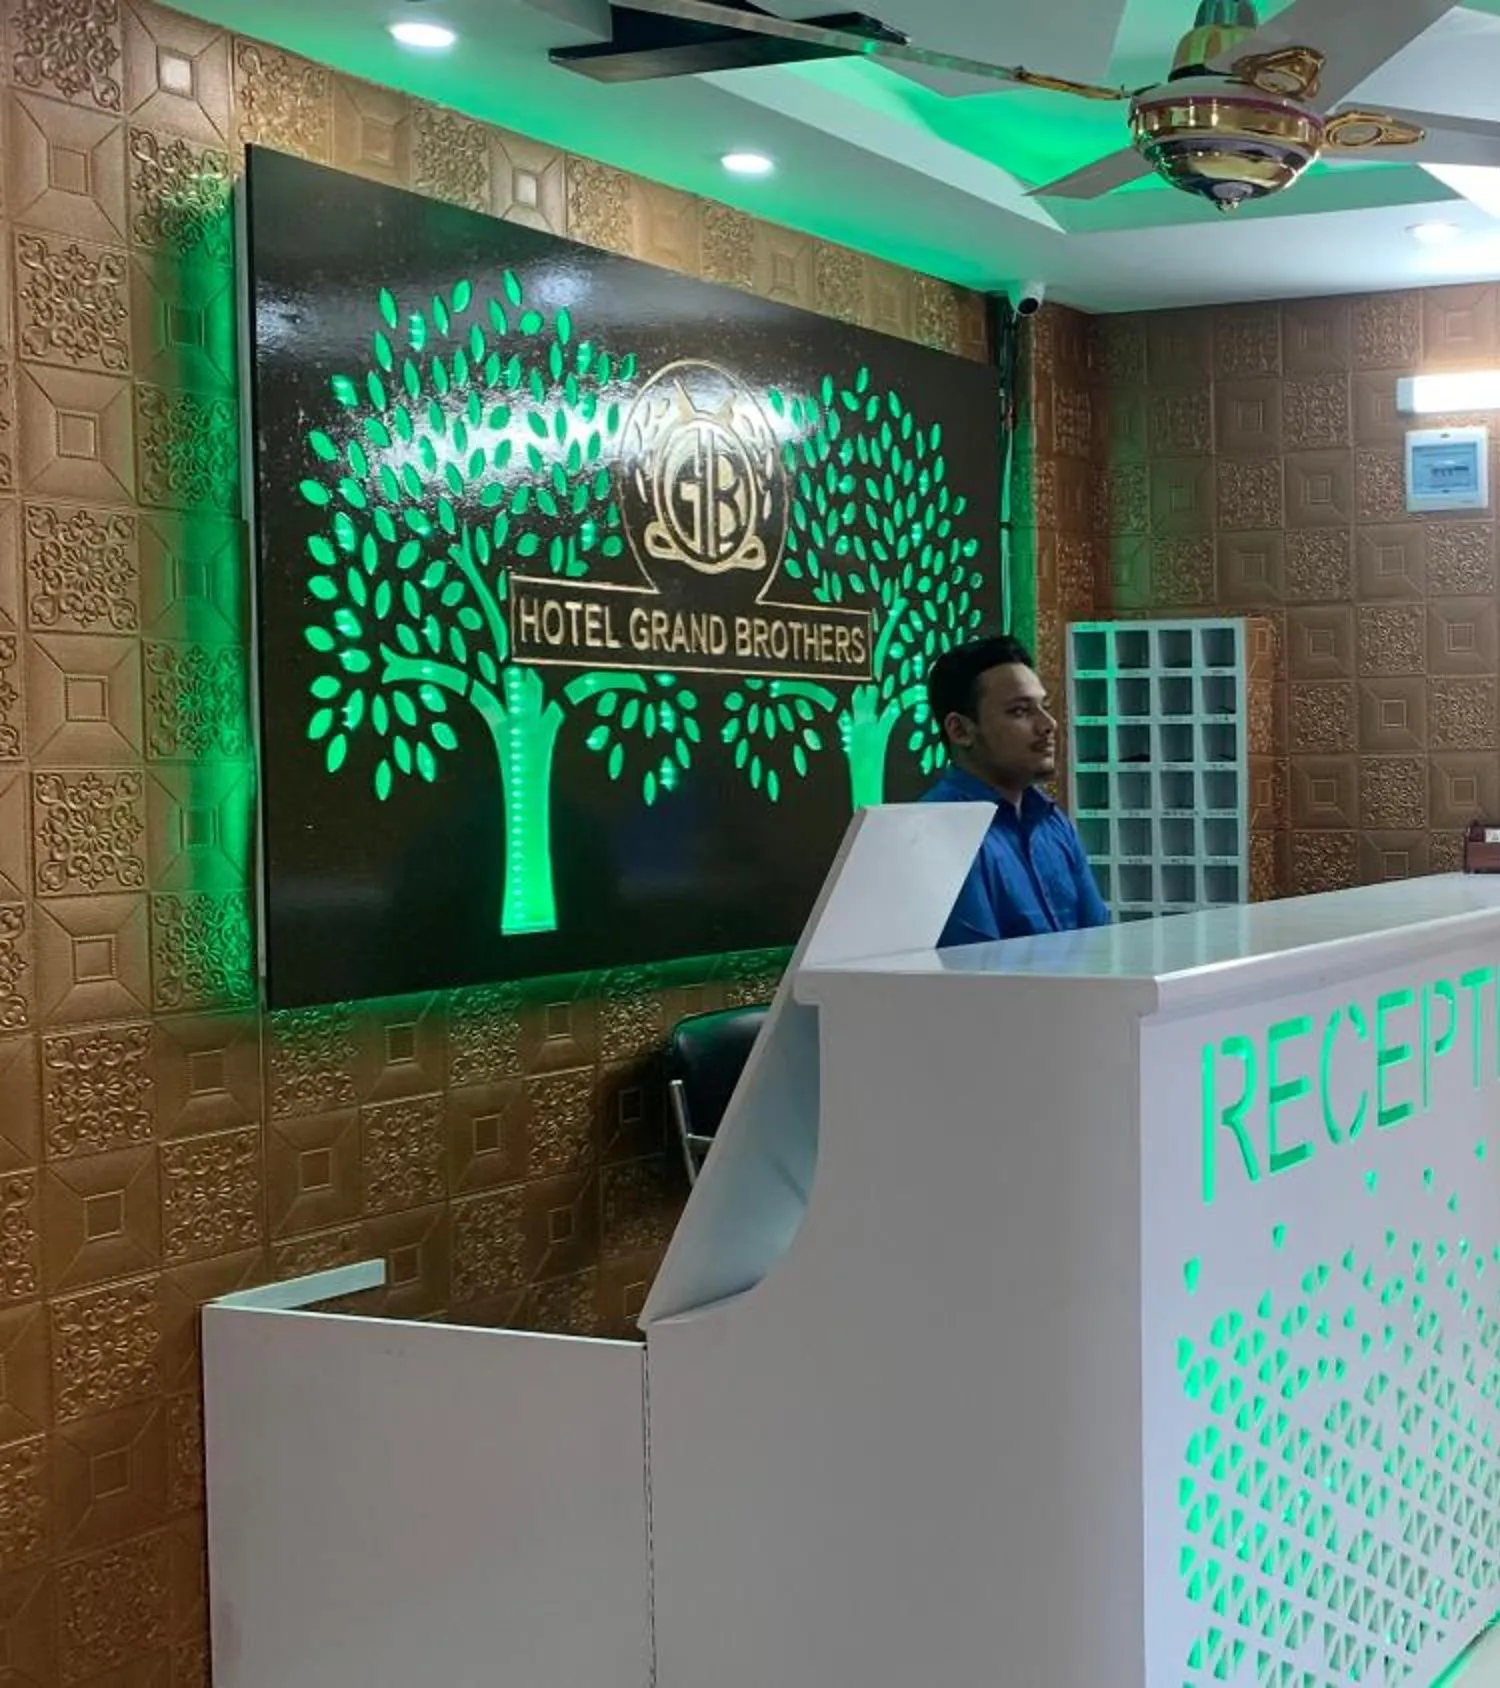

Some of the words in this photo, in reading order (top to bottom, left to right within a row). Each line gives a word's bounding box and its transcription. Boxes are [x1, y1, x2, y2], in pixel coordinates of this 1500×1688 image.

[519, 597, 621, 648] HOTEL
[629, 606, 728, 656] GRAND
[735, 616, 866, 664] BROTHERS
